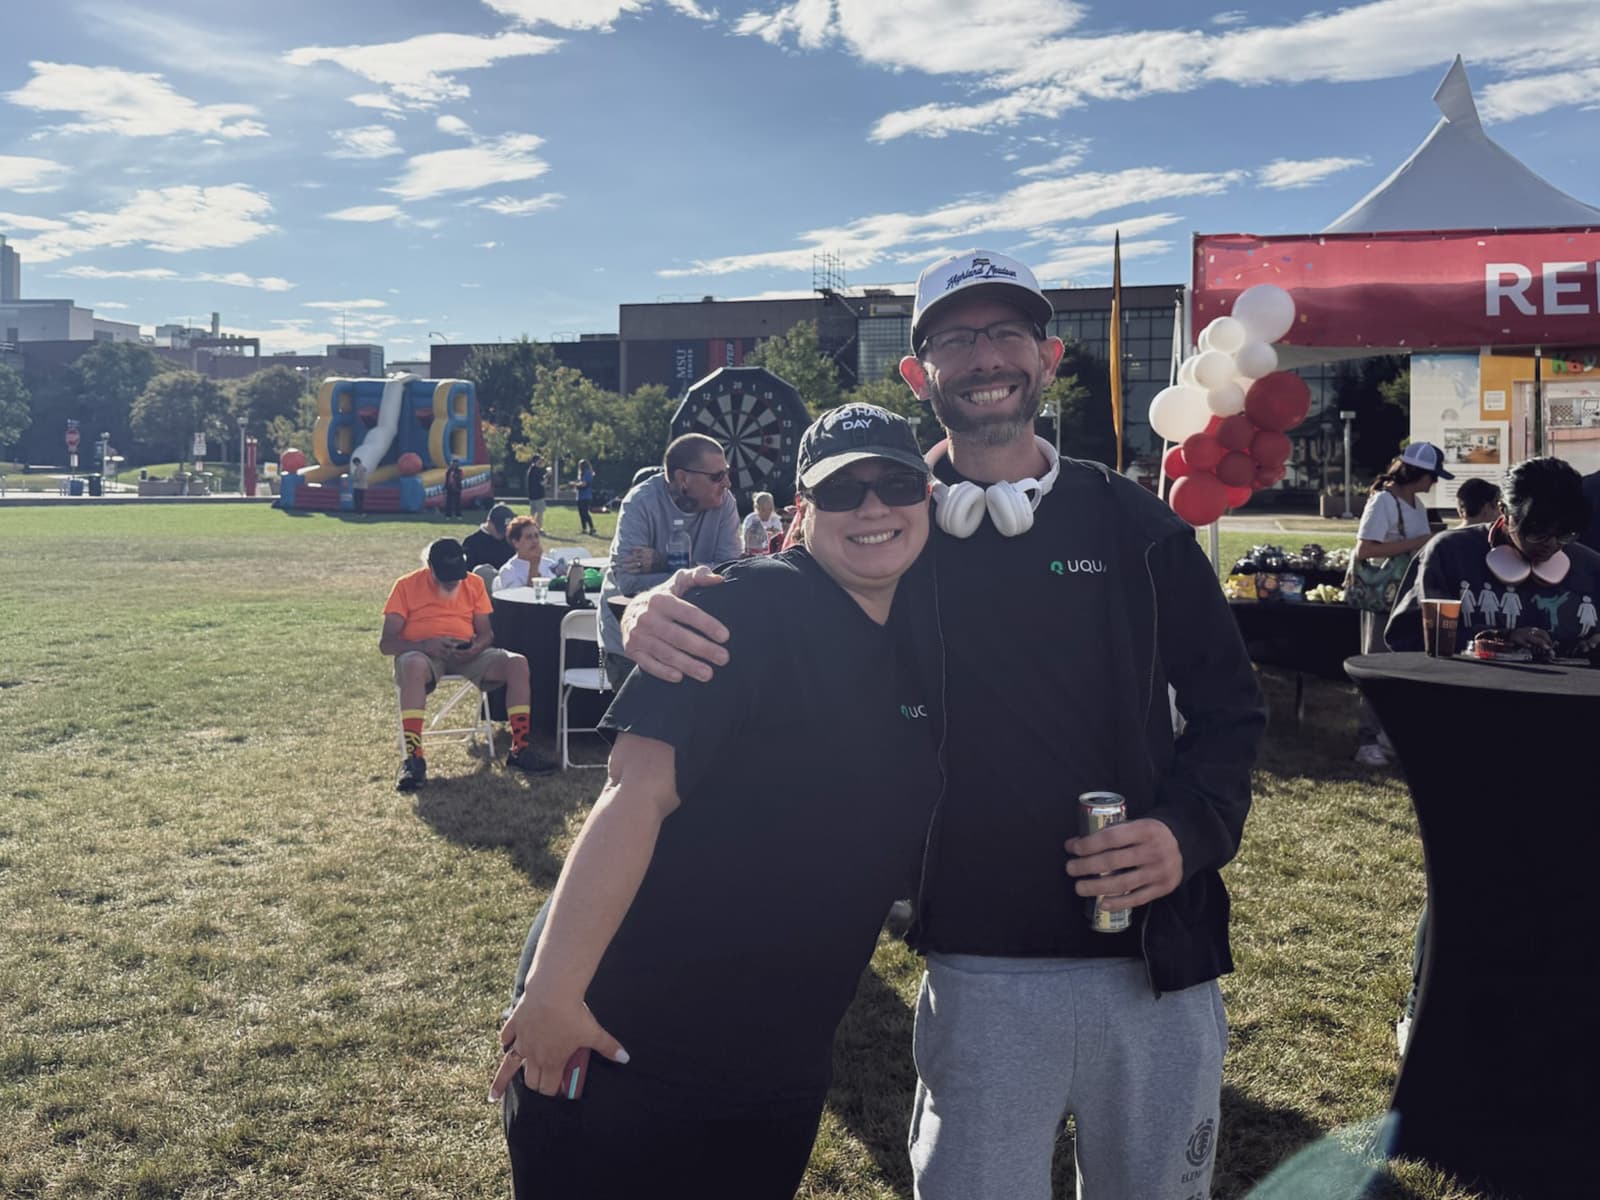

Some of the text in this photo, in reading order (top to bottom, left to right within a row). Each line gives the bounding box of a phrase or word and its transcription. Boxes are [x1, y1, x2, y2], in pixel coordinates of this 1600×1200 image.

[1485, 261, 1600, 316] RE
[842, 418, 872, 431] DAY
[1067, 559, 1107, 574] UQU
